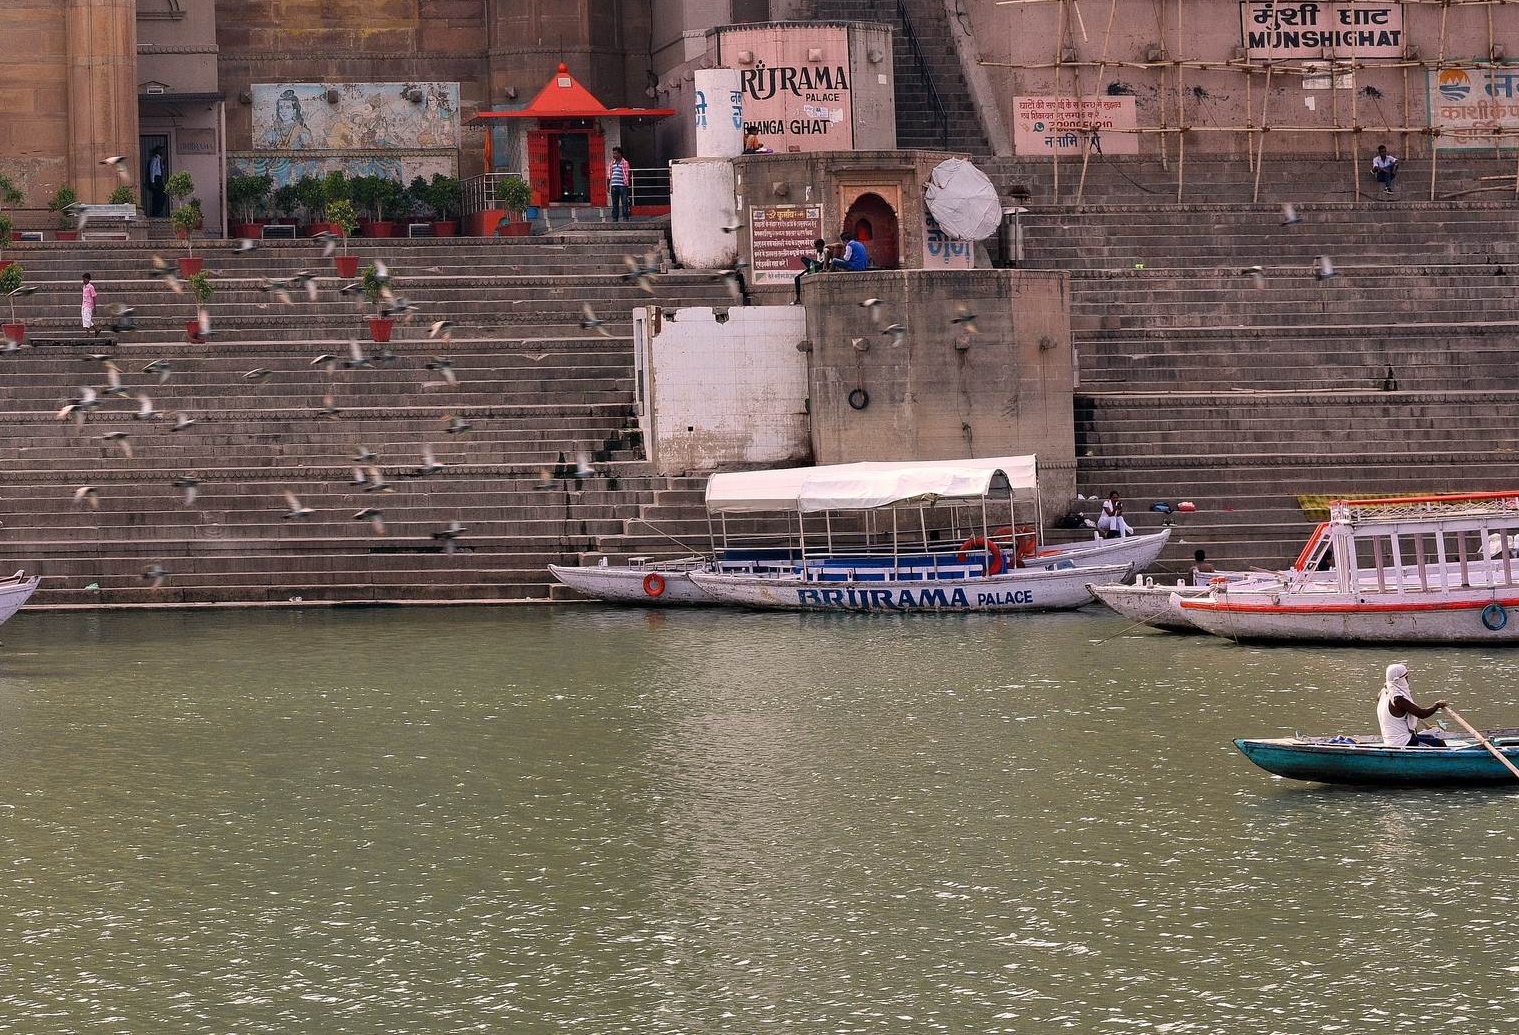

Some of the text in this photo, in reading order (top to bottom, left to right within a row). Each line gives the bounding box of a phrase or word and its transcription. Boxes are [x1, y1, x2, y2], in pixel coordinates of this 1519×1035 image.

[1253, 3, 1392, 31] मुंशी घाट
[1248, 30, 1401, 49] MUNSHIGHAT
[806, 93, 840, 102] PALACE
[790, 119, 831, 135] GHAT
[977, 590, 1033, 606] PALACE
